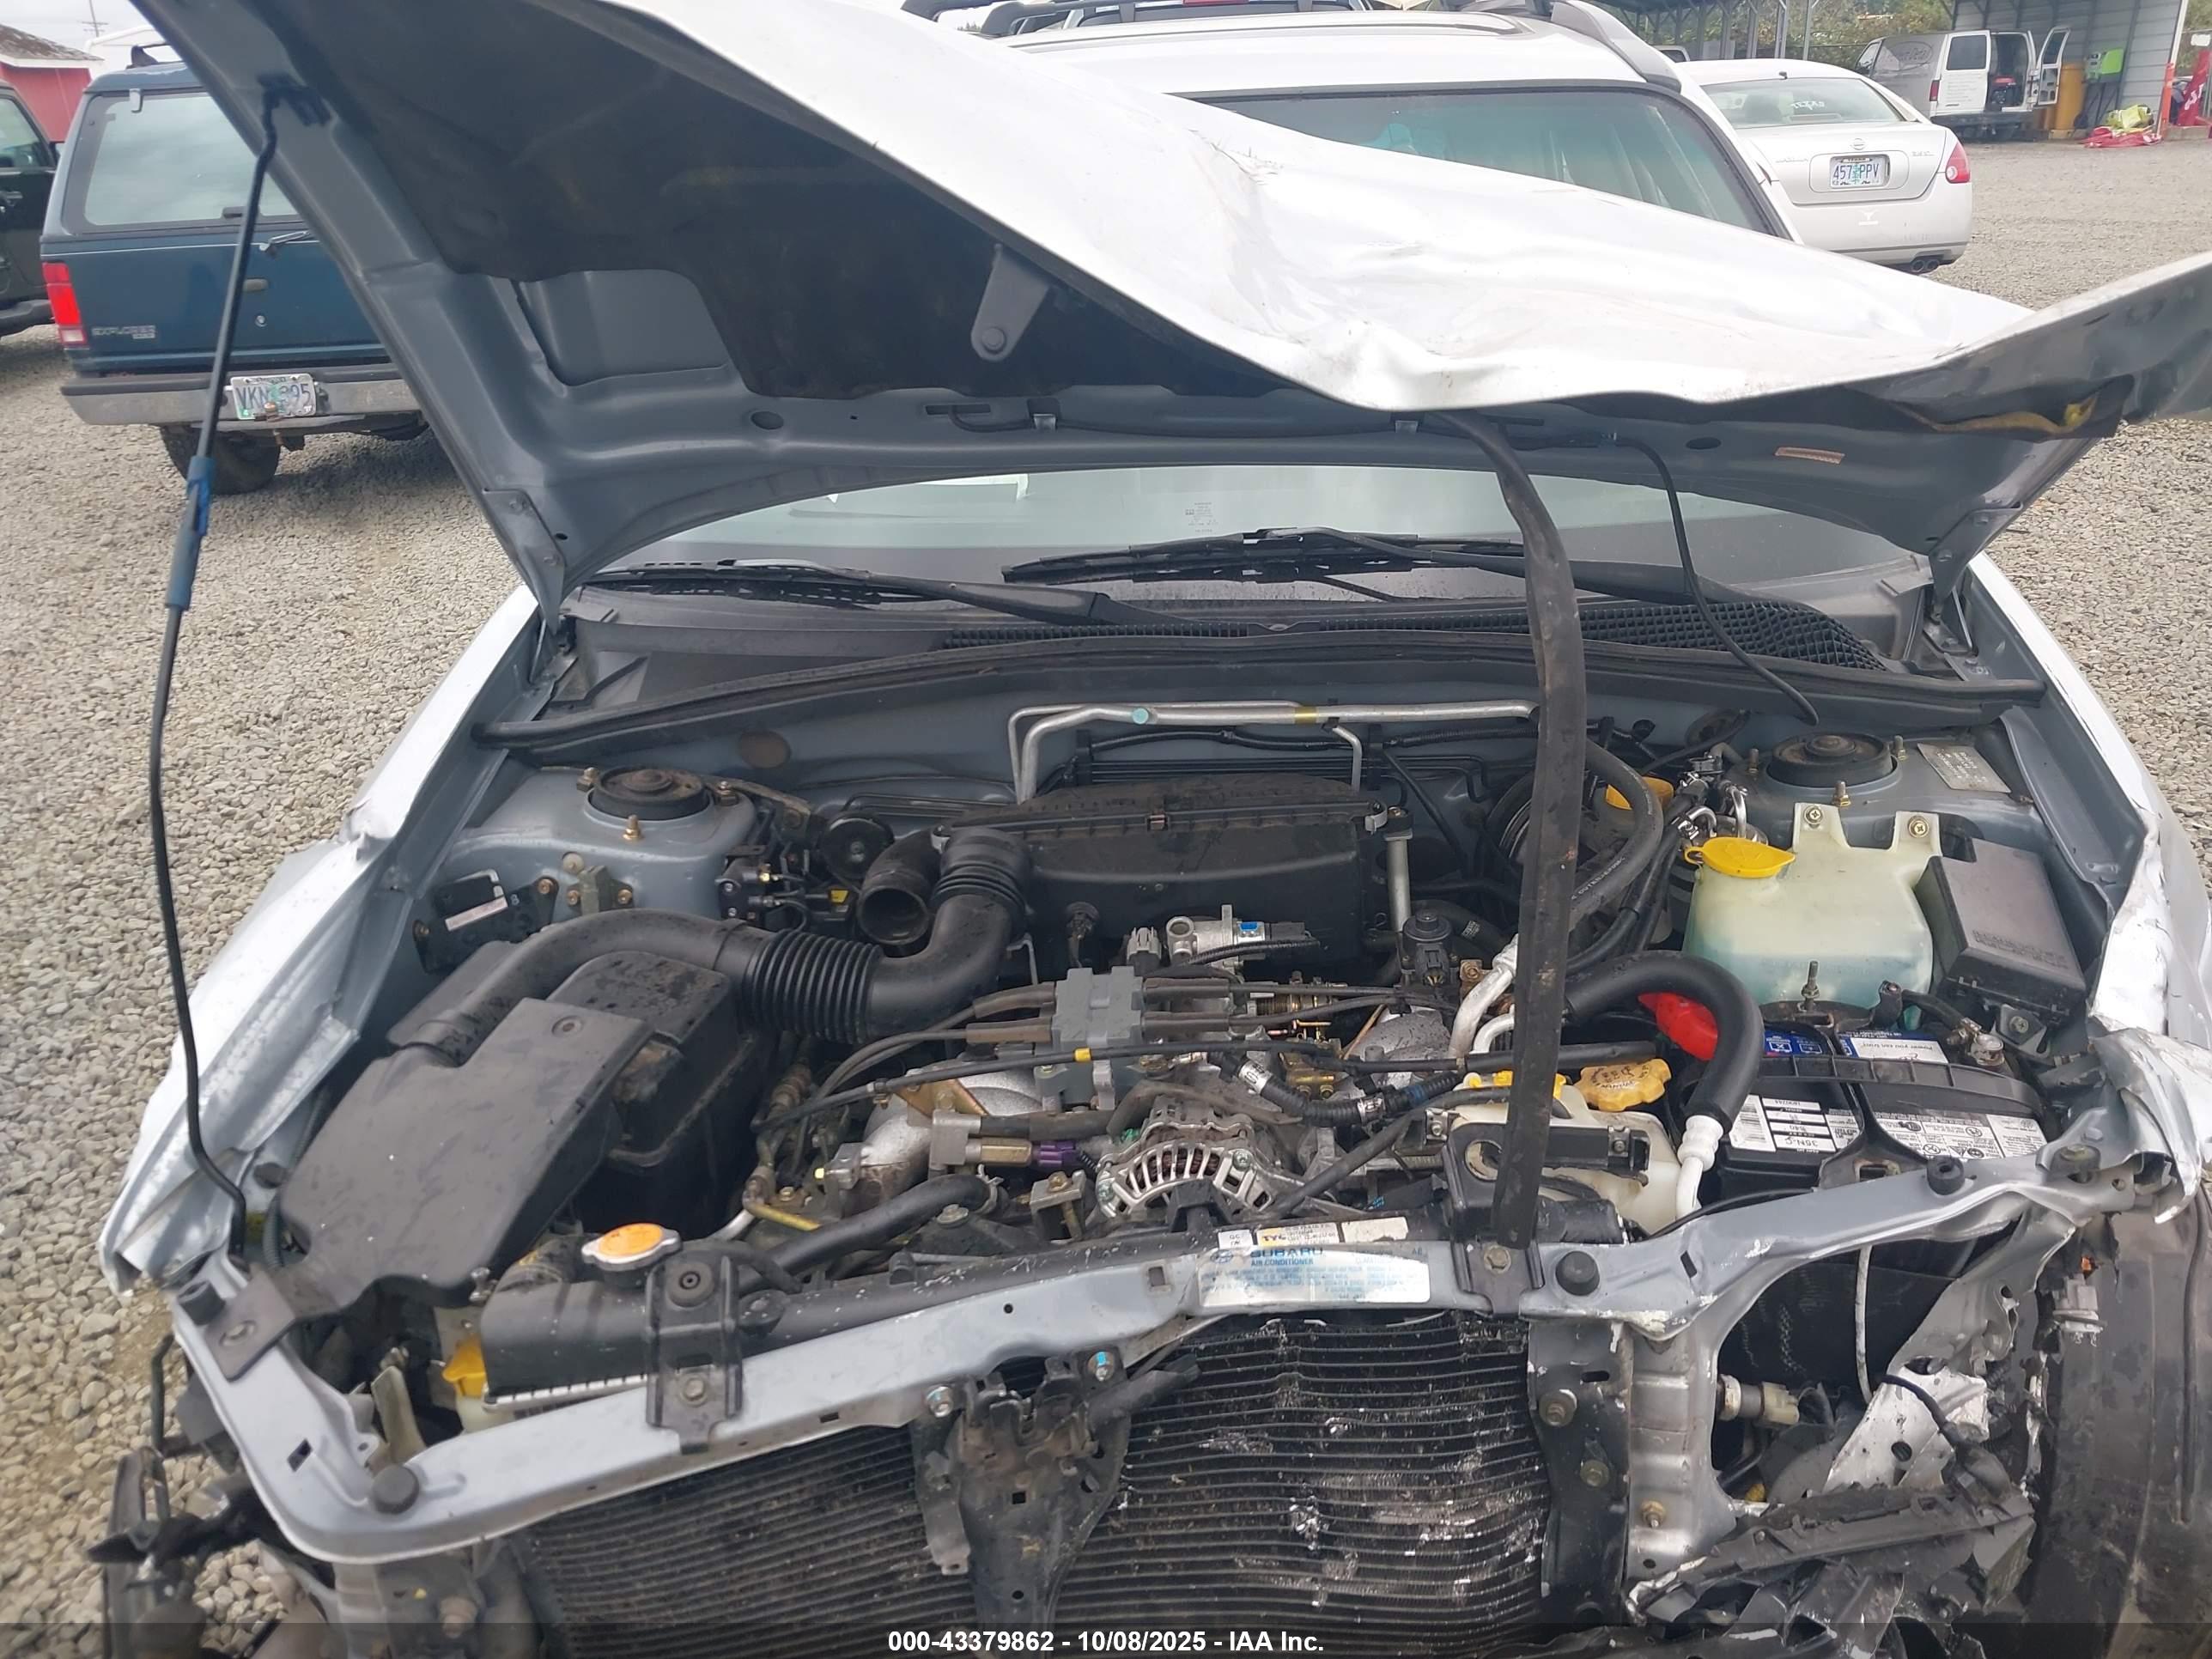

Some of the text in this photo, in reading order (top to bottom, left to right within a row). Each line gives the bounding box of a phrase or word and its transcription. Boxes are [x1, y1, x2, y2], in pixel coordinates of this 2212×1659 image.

[1833, 163, 1879, 179] 457 PPV
[1249, 1247, 1323, 1259] SUBARU
